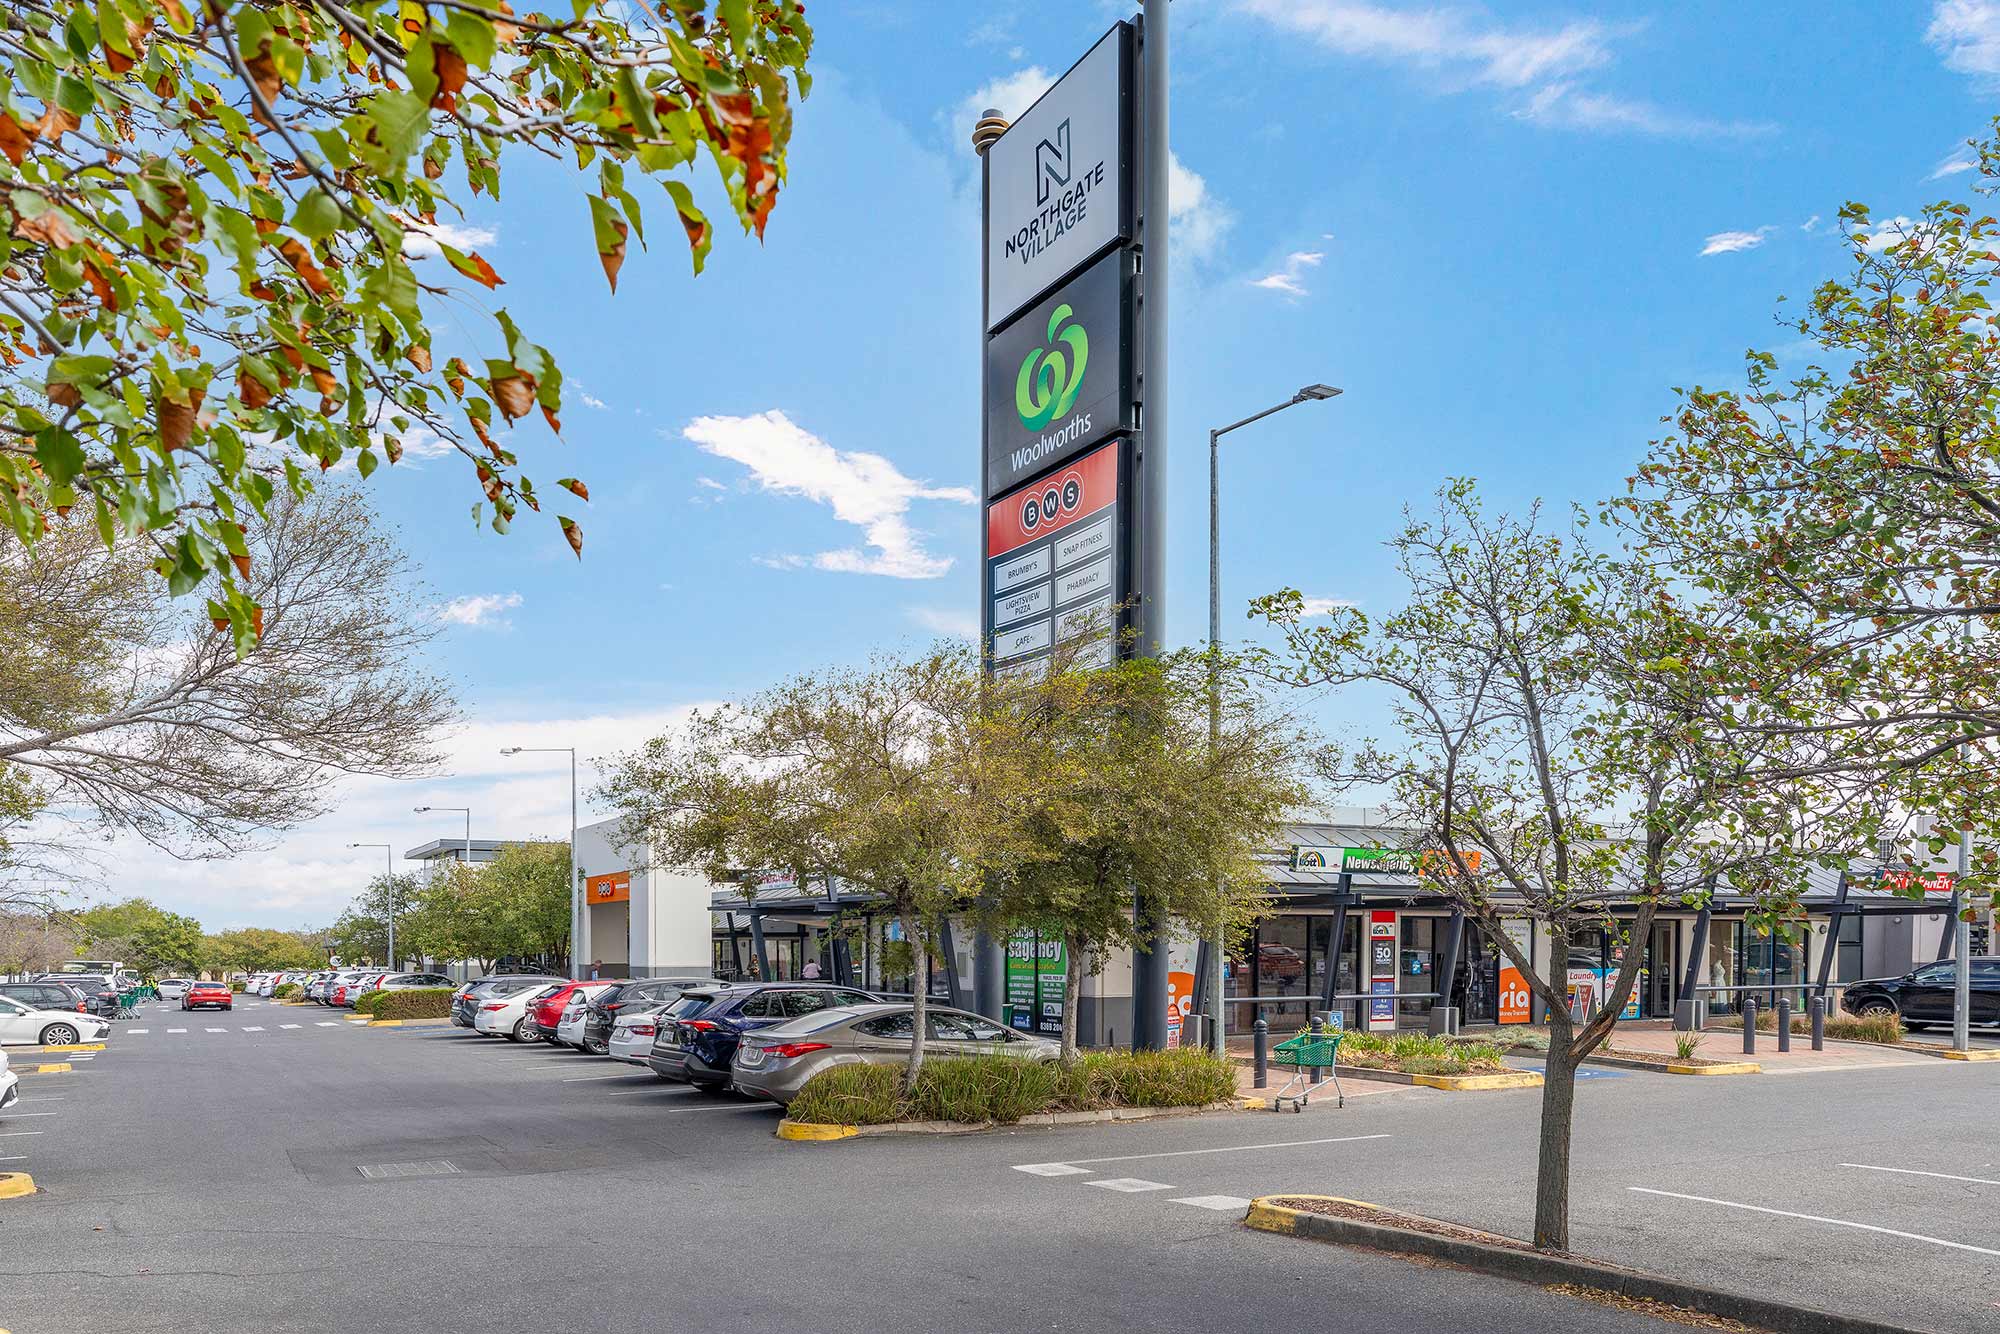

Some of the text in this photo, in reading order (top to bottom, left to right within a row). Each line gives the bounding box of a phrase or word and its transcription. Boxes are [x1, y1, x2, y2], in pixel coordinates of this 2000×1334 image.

[1005, 160, 1104, 258] NORTHGATE
[1020, 198, 1086, 265] VILLAGE
[1011, 412, 1092, 473] Woolworths
[1027, 486, 1076, 523] BWS
[1063, 532, 1103, 557] SNAP FITNESS
[1007, 560, 1038, 579] BRUMBY'S
[1066, 572, 1100, 592] PHARMACY
[1005, 591, 1041, 610] LIGHTSVIEW
[1014, 605, 1031, 616] PIZZA
[1008, 940, 1062, 962] sagency
[1375, 947, 1391, 958] 50
[1569, 971, 1597, 981] Laundry
[1499, 982, 1529, 1009] ria
